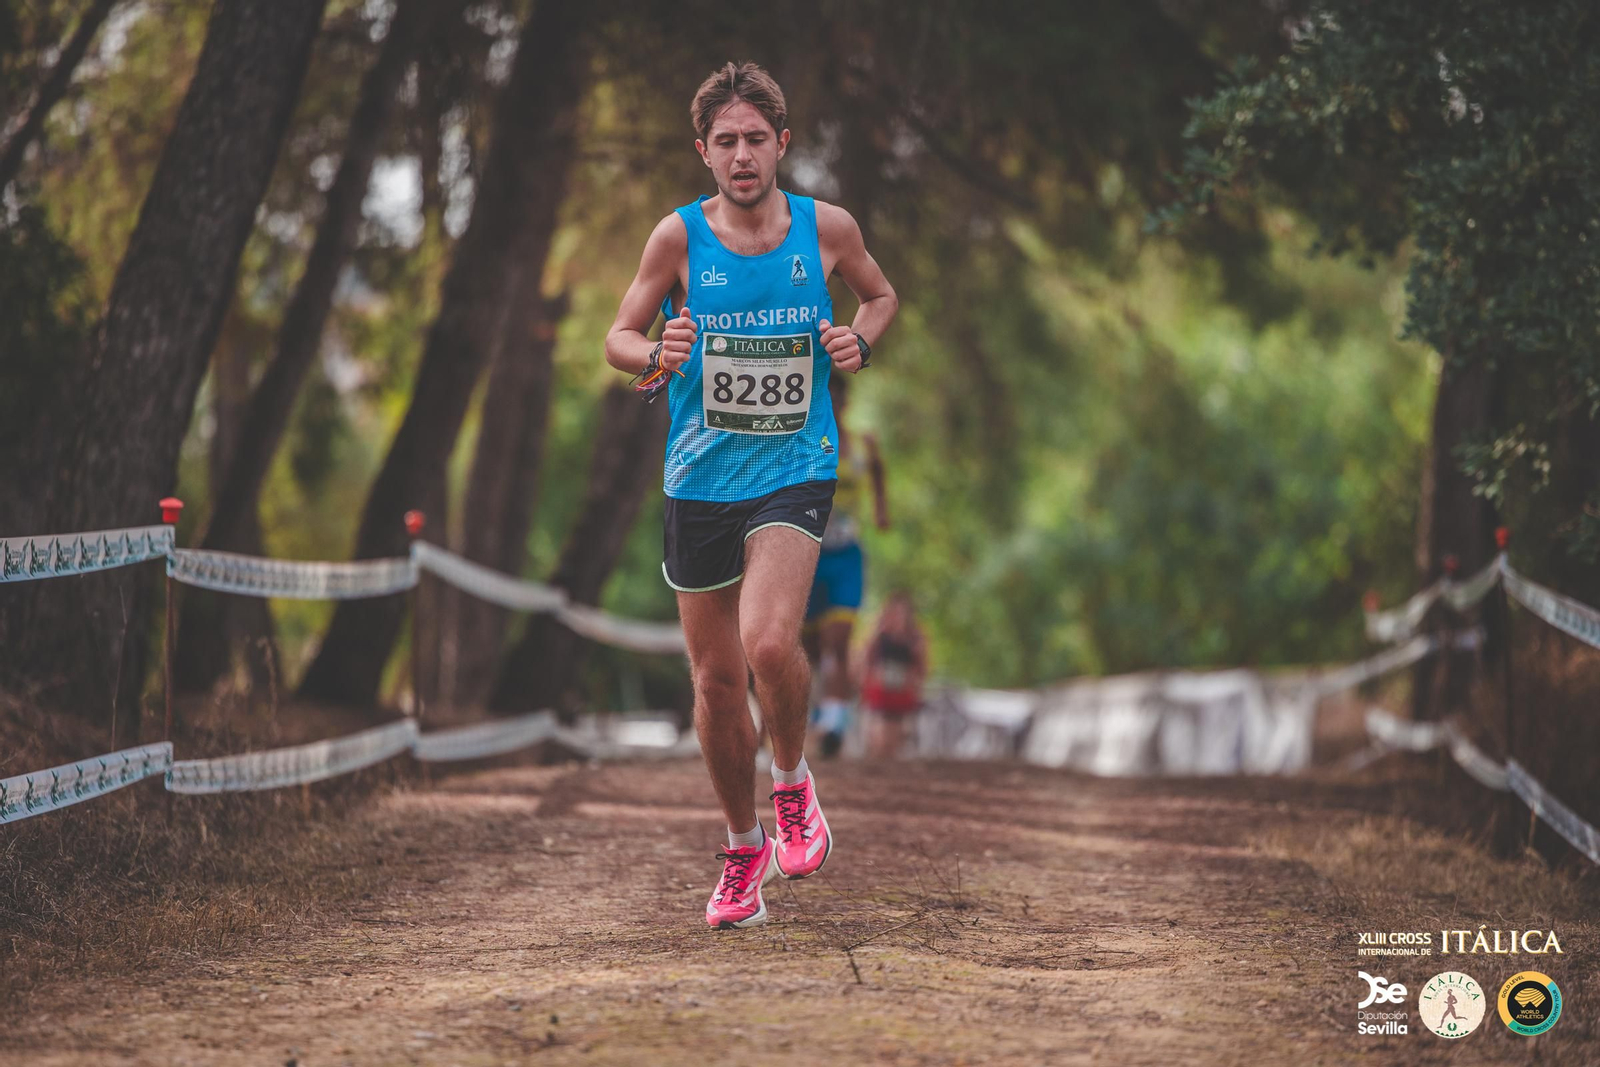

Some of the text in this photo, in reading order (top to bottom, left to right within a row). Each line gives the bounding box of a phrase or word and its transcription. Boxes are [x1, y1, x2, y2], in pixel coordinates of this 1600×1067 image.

[701, 265, 728, 286] als
[696, 305, 818, 330] TROTASIERRA
[733, 339, 786, 352] ITÁLICA
[713, 372, 805, 407] 8288
